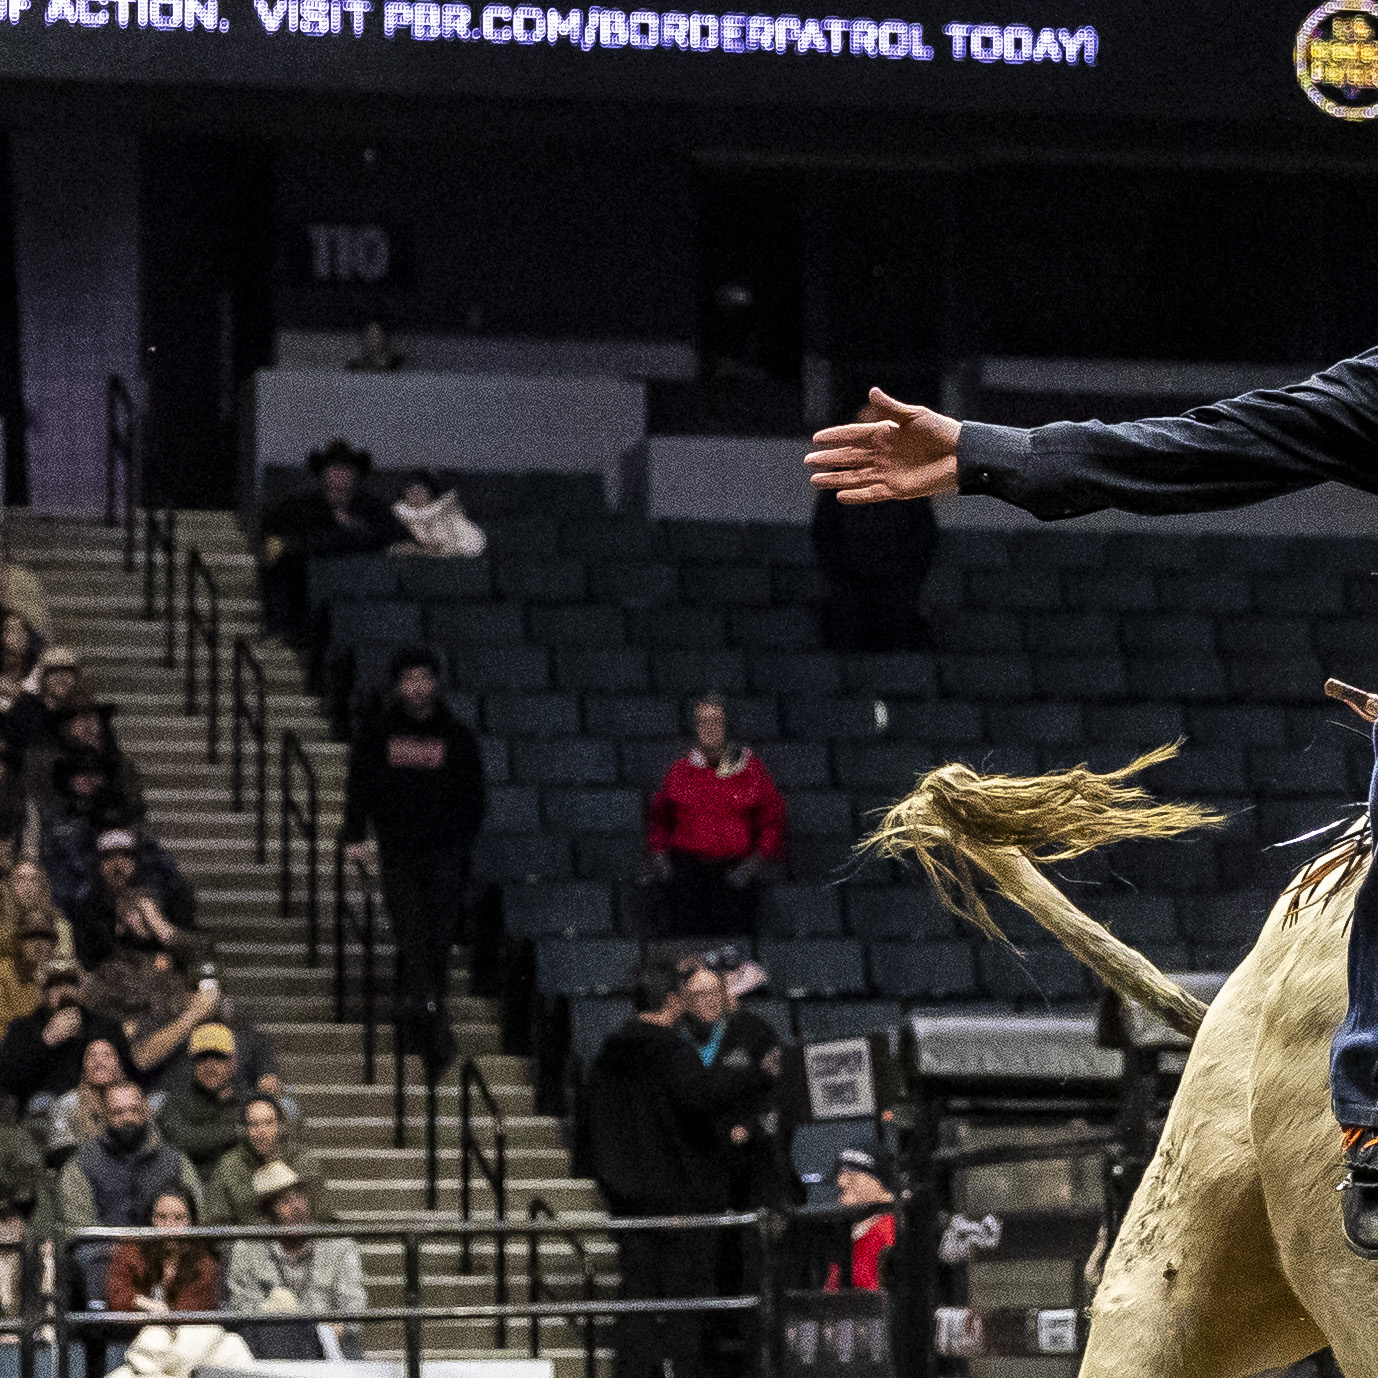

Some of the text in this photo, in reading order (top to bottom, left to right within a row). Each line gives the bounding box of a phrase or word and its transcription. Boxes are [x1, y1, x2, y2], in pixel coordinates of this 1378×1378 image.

[253, 0, 371, 38] VISIT
[384, 2, 936, 61] PBR.COM/BORDERPATROL
[941, 21, 1100, 67] TODAY!
[305, 223, 391, 282] 110
